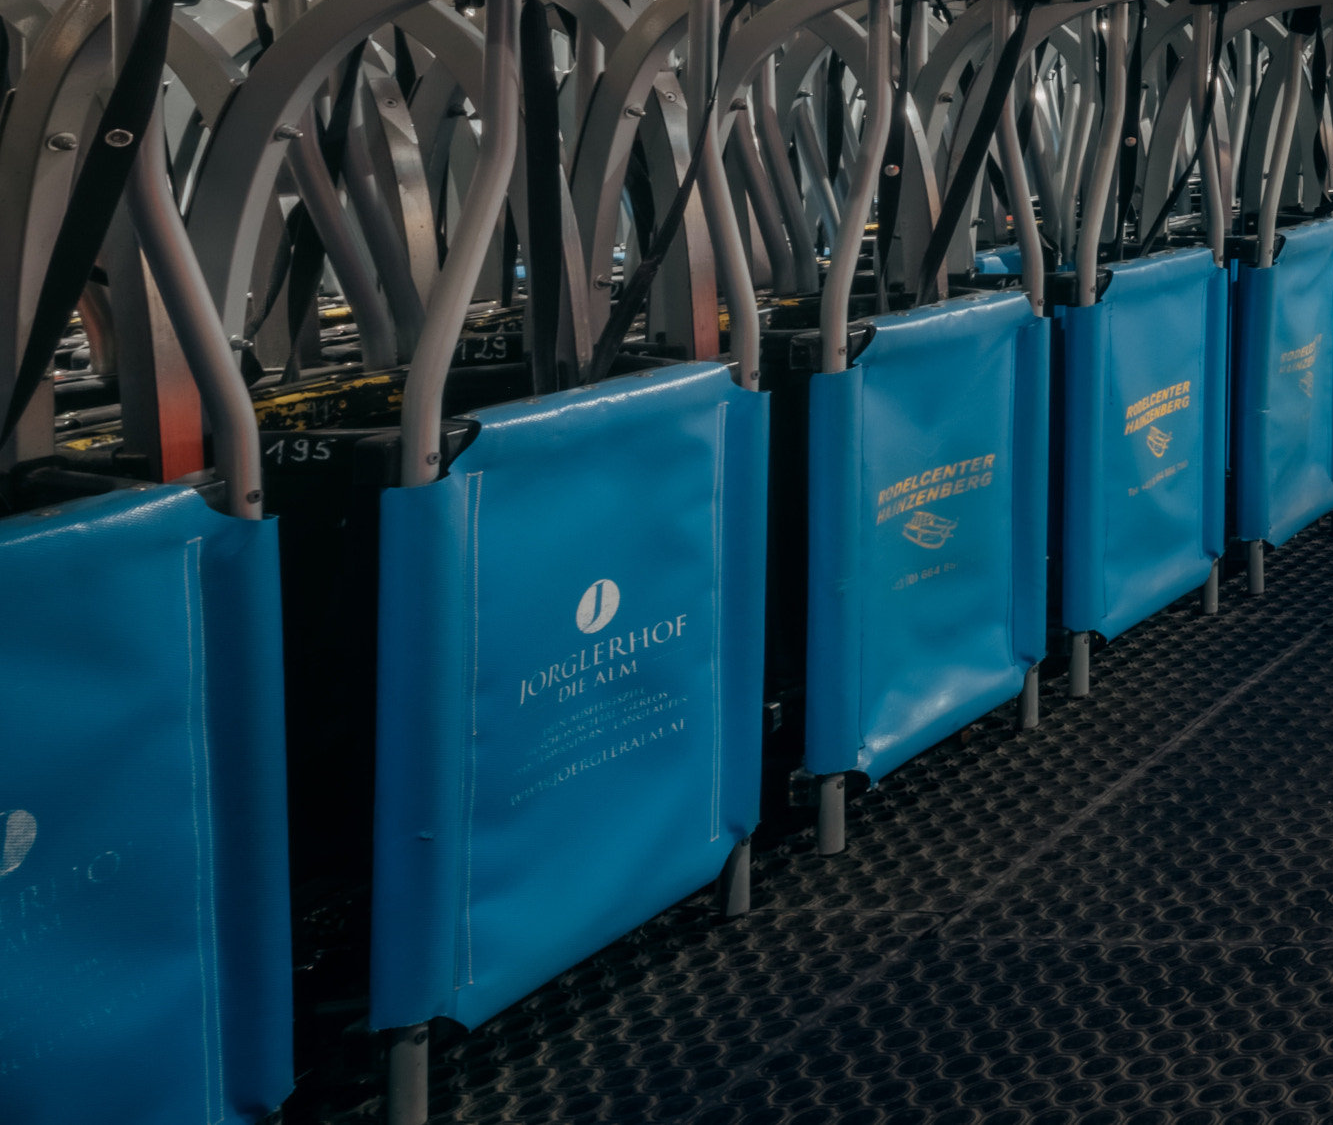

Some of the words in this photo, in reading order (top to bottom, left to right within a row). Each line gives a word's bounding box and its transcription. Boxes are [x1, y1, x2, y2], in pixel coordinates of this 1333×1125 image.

[1124, 395, 1190, 436] HAINZENBERG
[1126, 381, 1190, 419] RODELCENTER
[265, 438, 337, 465] 195
[876, 471, 993, 525] HAINZENBERG
[878, 453, 996, 505] RODELCENTER
[559, 677, 586, 703] DIE
